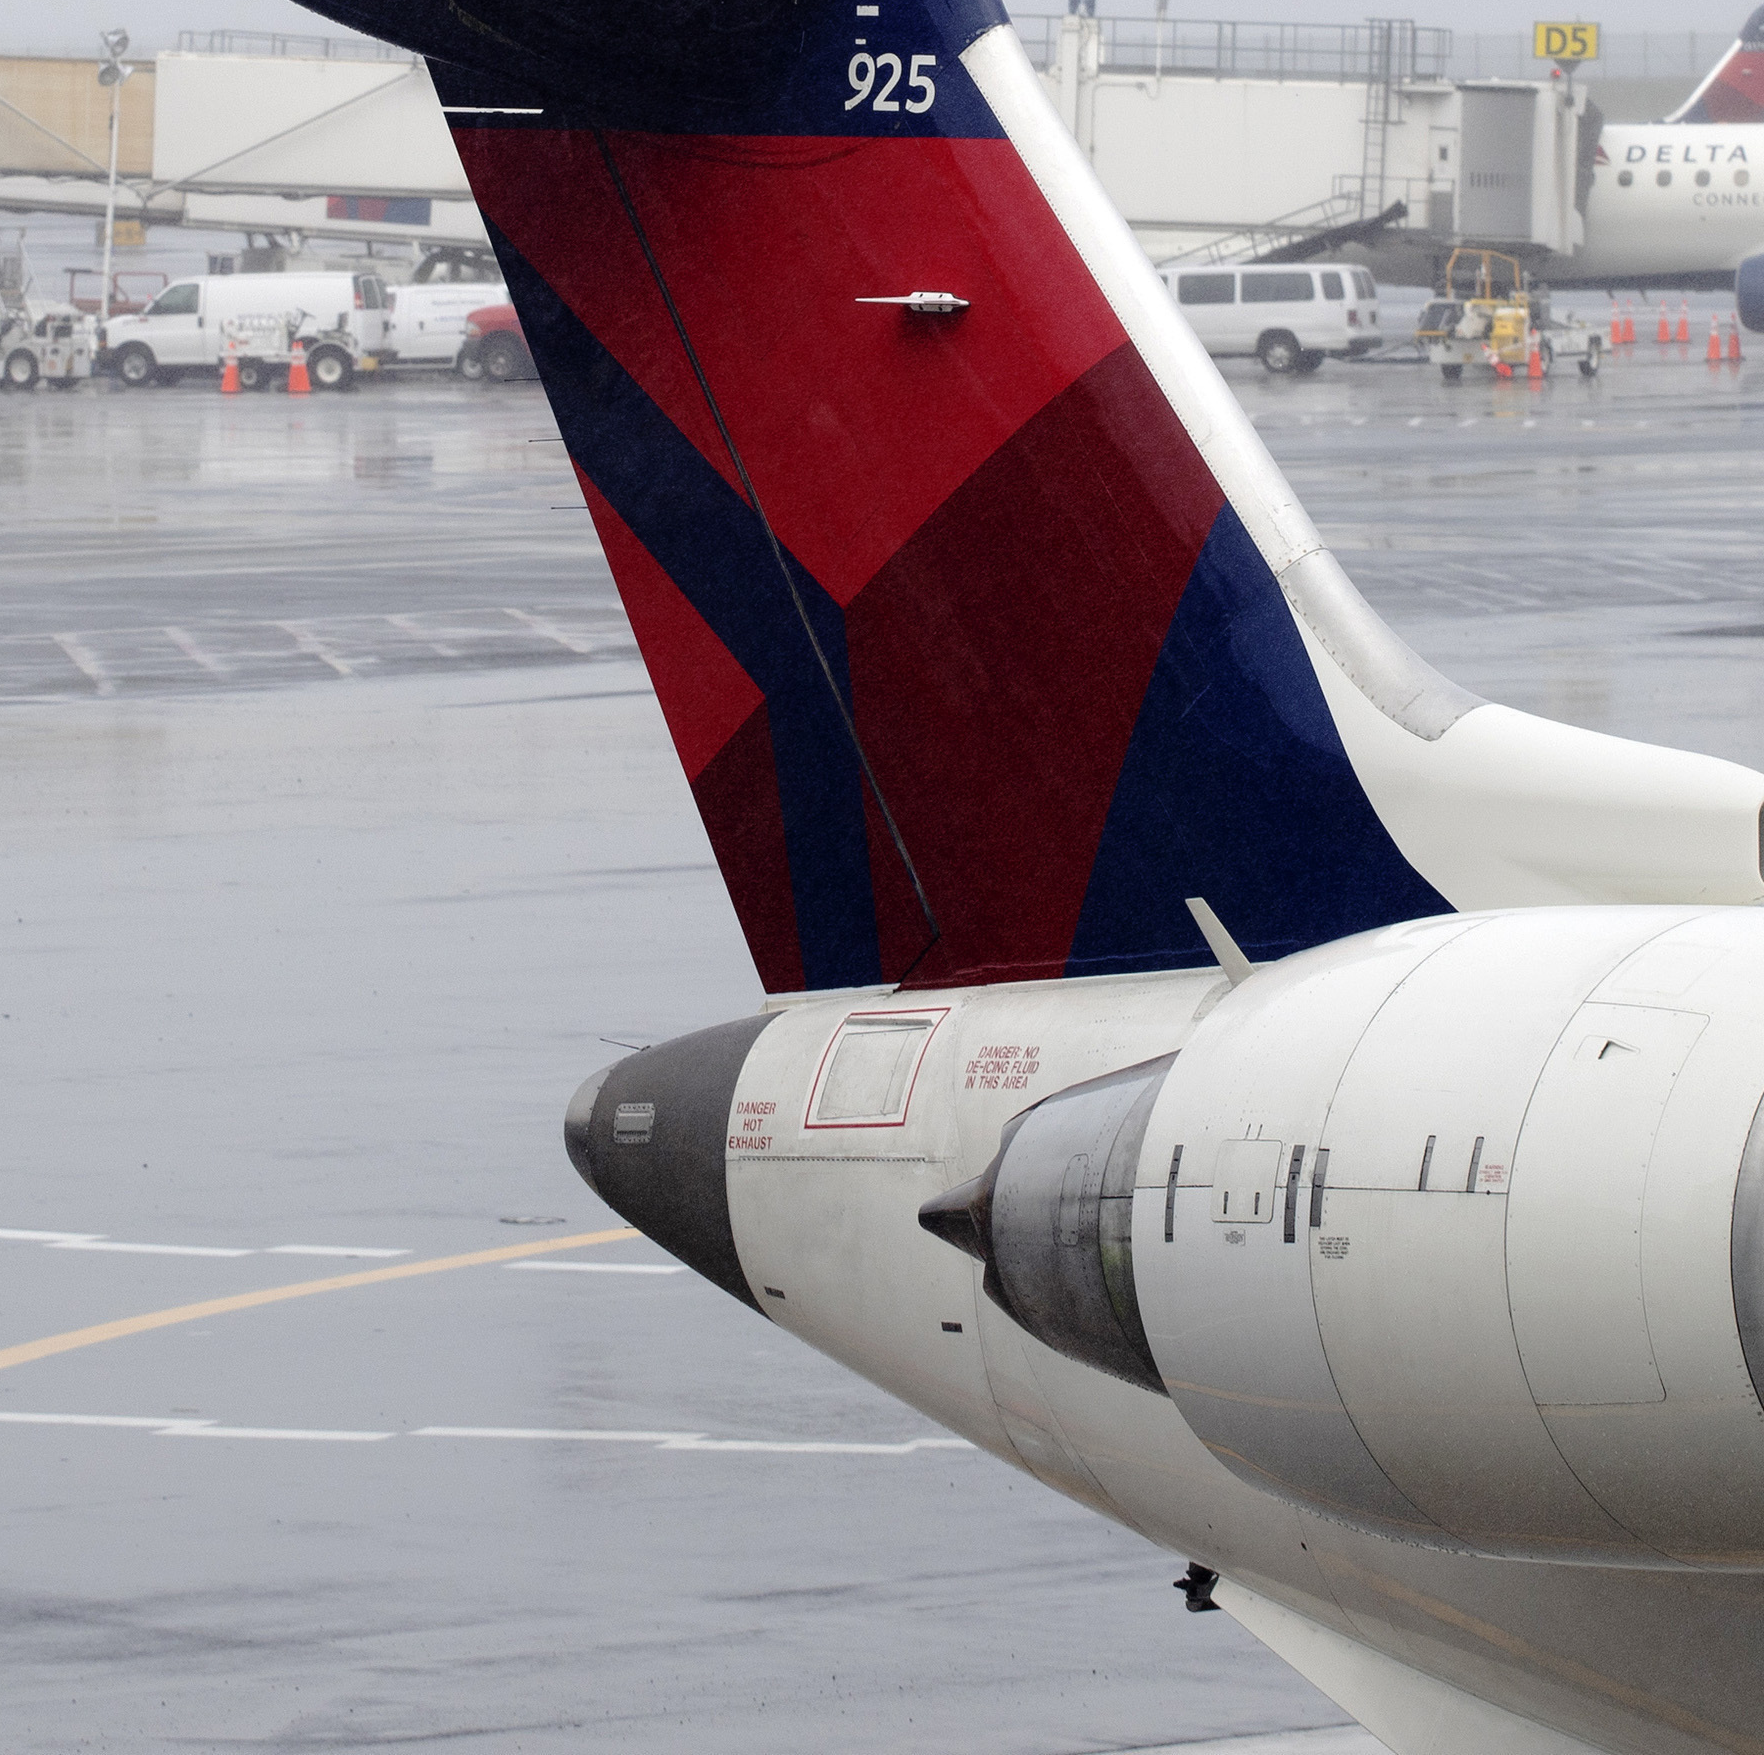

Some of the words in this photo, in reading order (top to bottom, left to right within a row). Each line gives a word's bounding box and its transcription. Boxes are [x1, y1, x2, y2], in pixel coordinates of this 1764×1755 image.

[1546, 28, 1587, 55] D5
[845, 52, 936, 114] 925
[1626, 145, 1748, 163] DELTA
[1022, 1045, 1040, 1059] NO
[965, 1060, 1010, 1074] DE-ICING
[1010, 1060, 1040, 1074] FLUID
[964, 1075, 976, 1089] IN
[979, 1075, 1000, 1089] THIS
[1001, 1075, 1028, 1089] AREA
[736, 1101, 777, 1115] DANGER
[742, 1118, 763, 1132] HOT
[728, 1135, 773, 1150] EXHAUST
